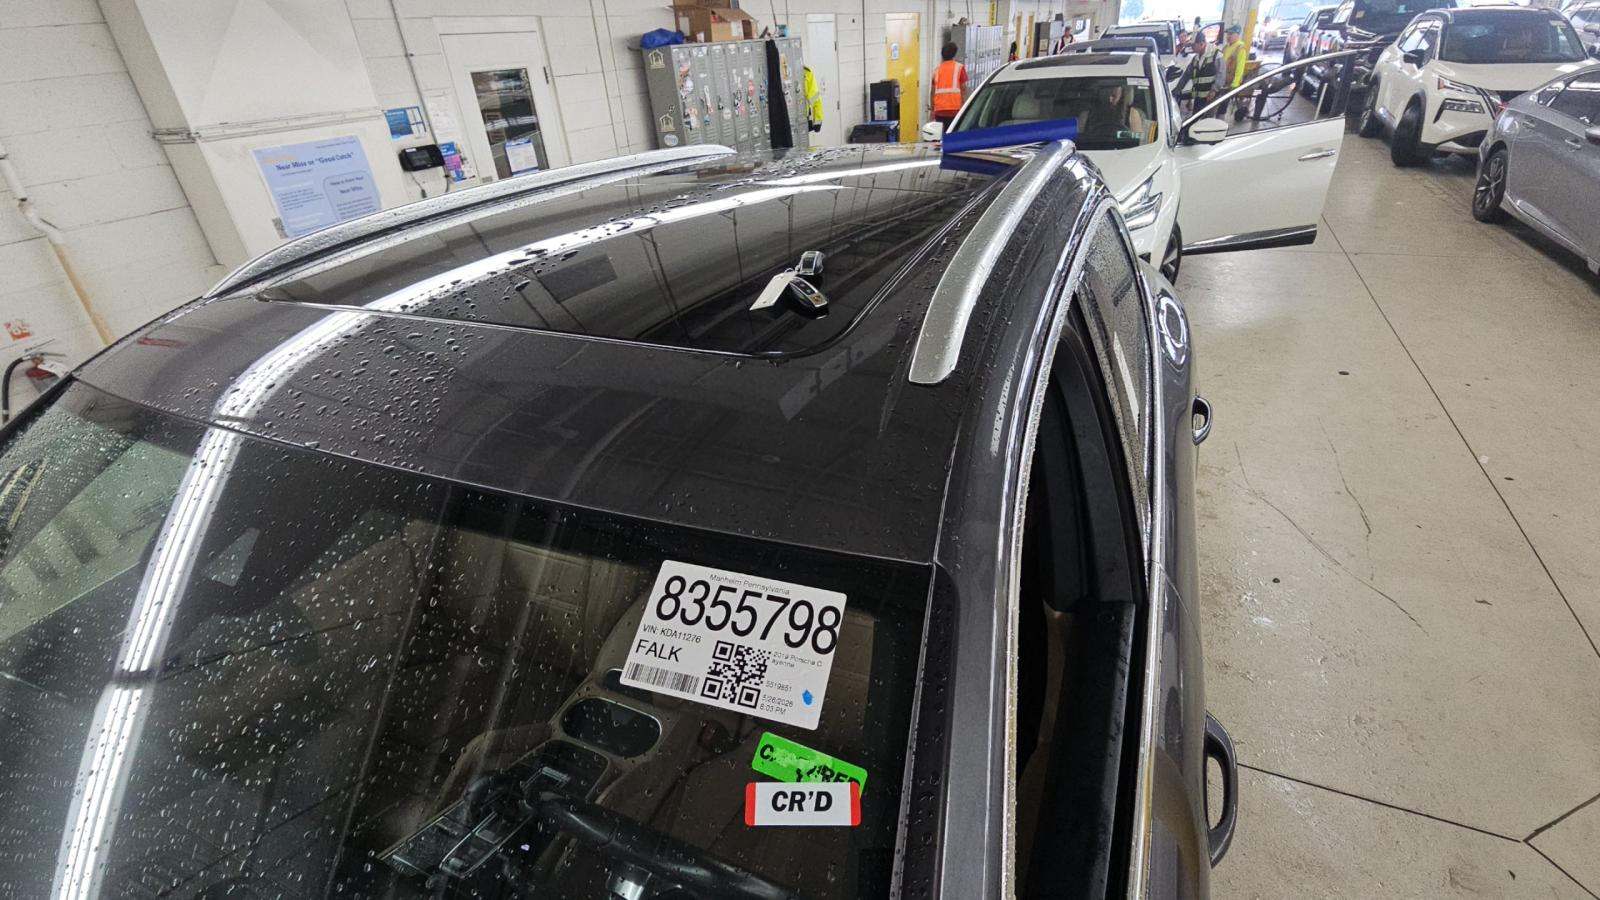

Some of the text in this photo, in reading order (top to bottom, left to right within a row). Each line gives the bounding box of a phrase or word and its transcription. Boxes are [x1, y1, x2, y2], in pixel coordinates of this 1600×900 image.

[710, 573, 790, 596] Manheim Pennsylvania
[656, 575, 841, 655] 8355798
[643, 624, 702, 644] VIN: KDA11276
[635, 638, 683, 663] FALK
[775, 706, 787, 715] PM
[771, 790, 833, 812] CR'D
